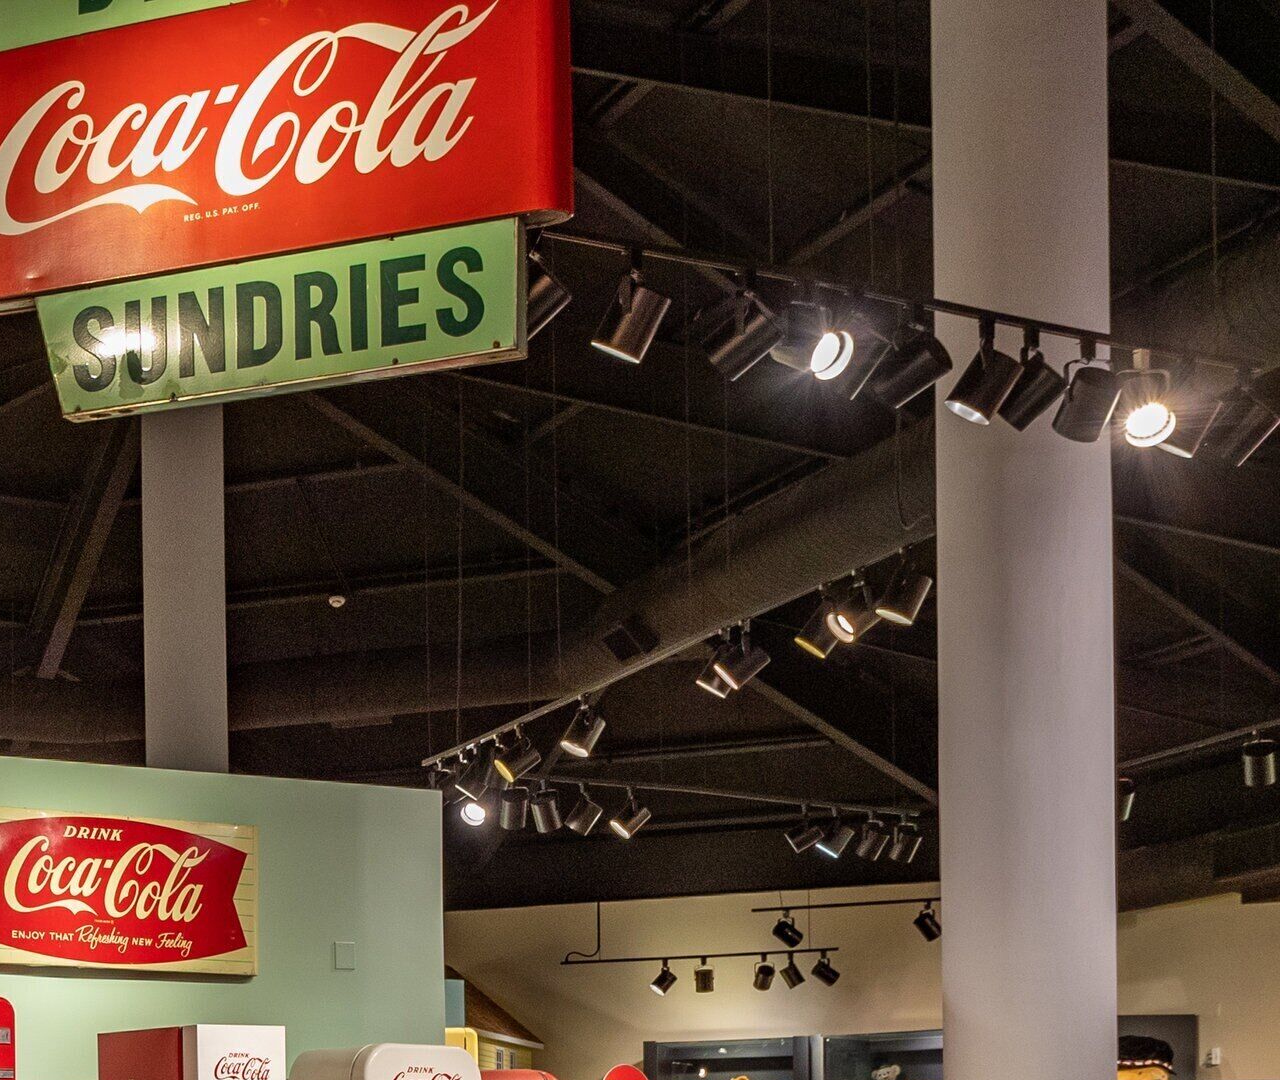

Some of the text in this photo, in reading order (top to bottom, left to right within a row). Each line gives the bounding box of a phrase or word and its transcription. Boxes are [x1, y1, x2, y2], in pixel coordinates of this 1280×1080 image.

[182, 202, 261, 223] REG. U.S. PAT. OFF.
[71, 245, 484, 393] SUNDRIES
[63, 825, 124, 842] DRINK
[2, 834, 211, 923] Coca-Cola
[11, 924, 193, 958] ENJOY THAT Refreshing NEW Feeling
[214, 1056, 271, 1080] Coca-Cola
[407, 1066, 436, 1074] DRINK
